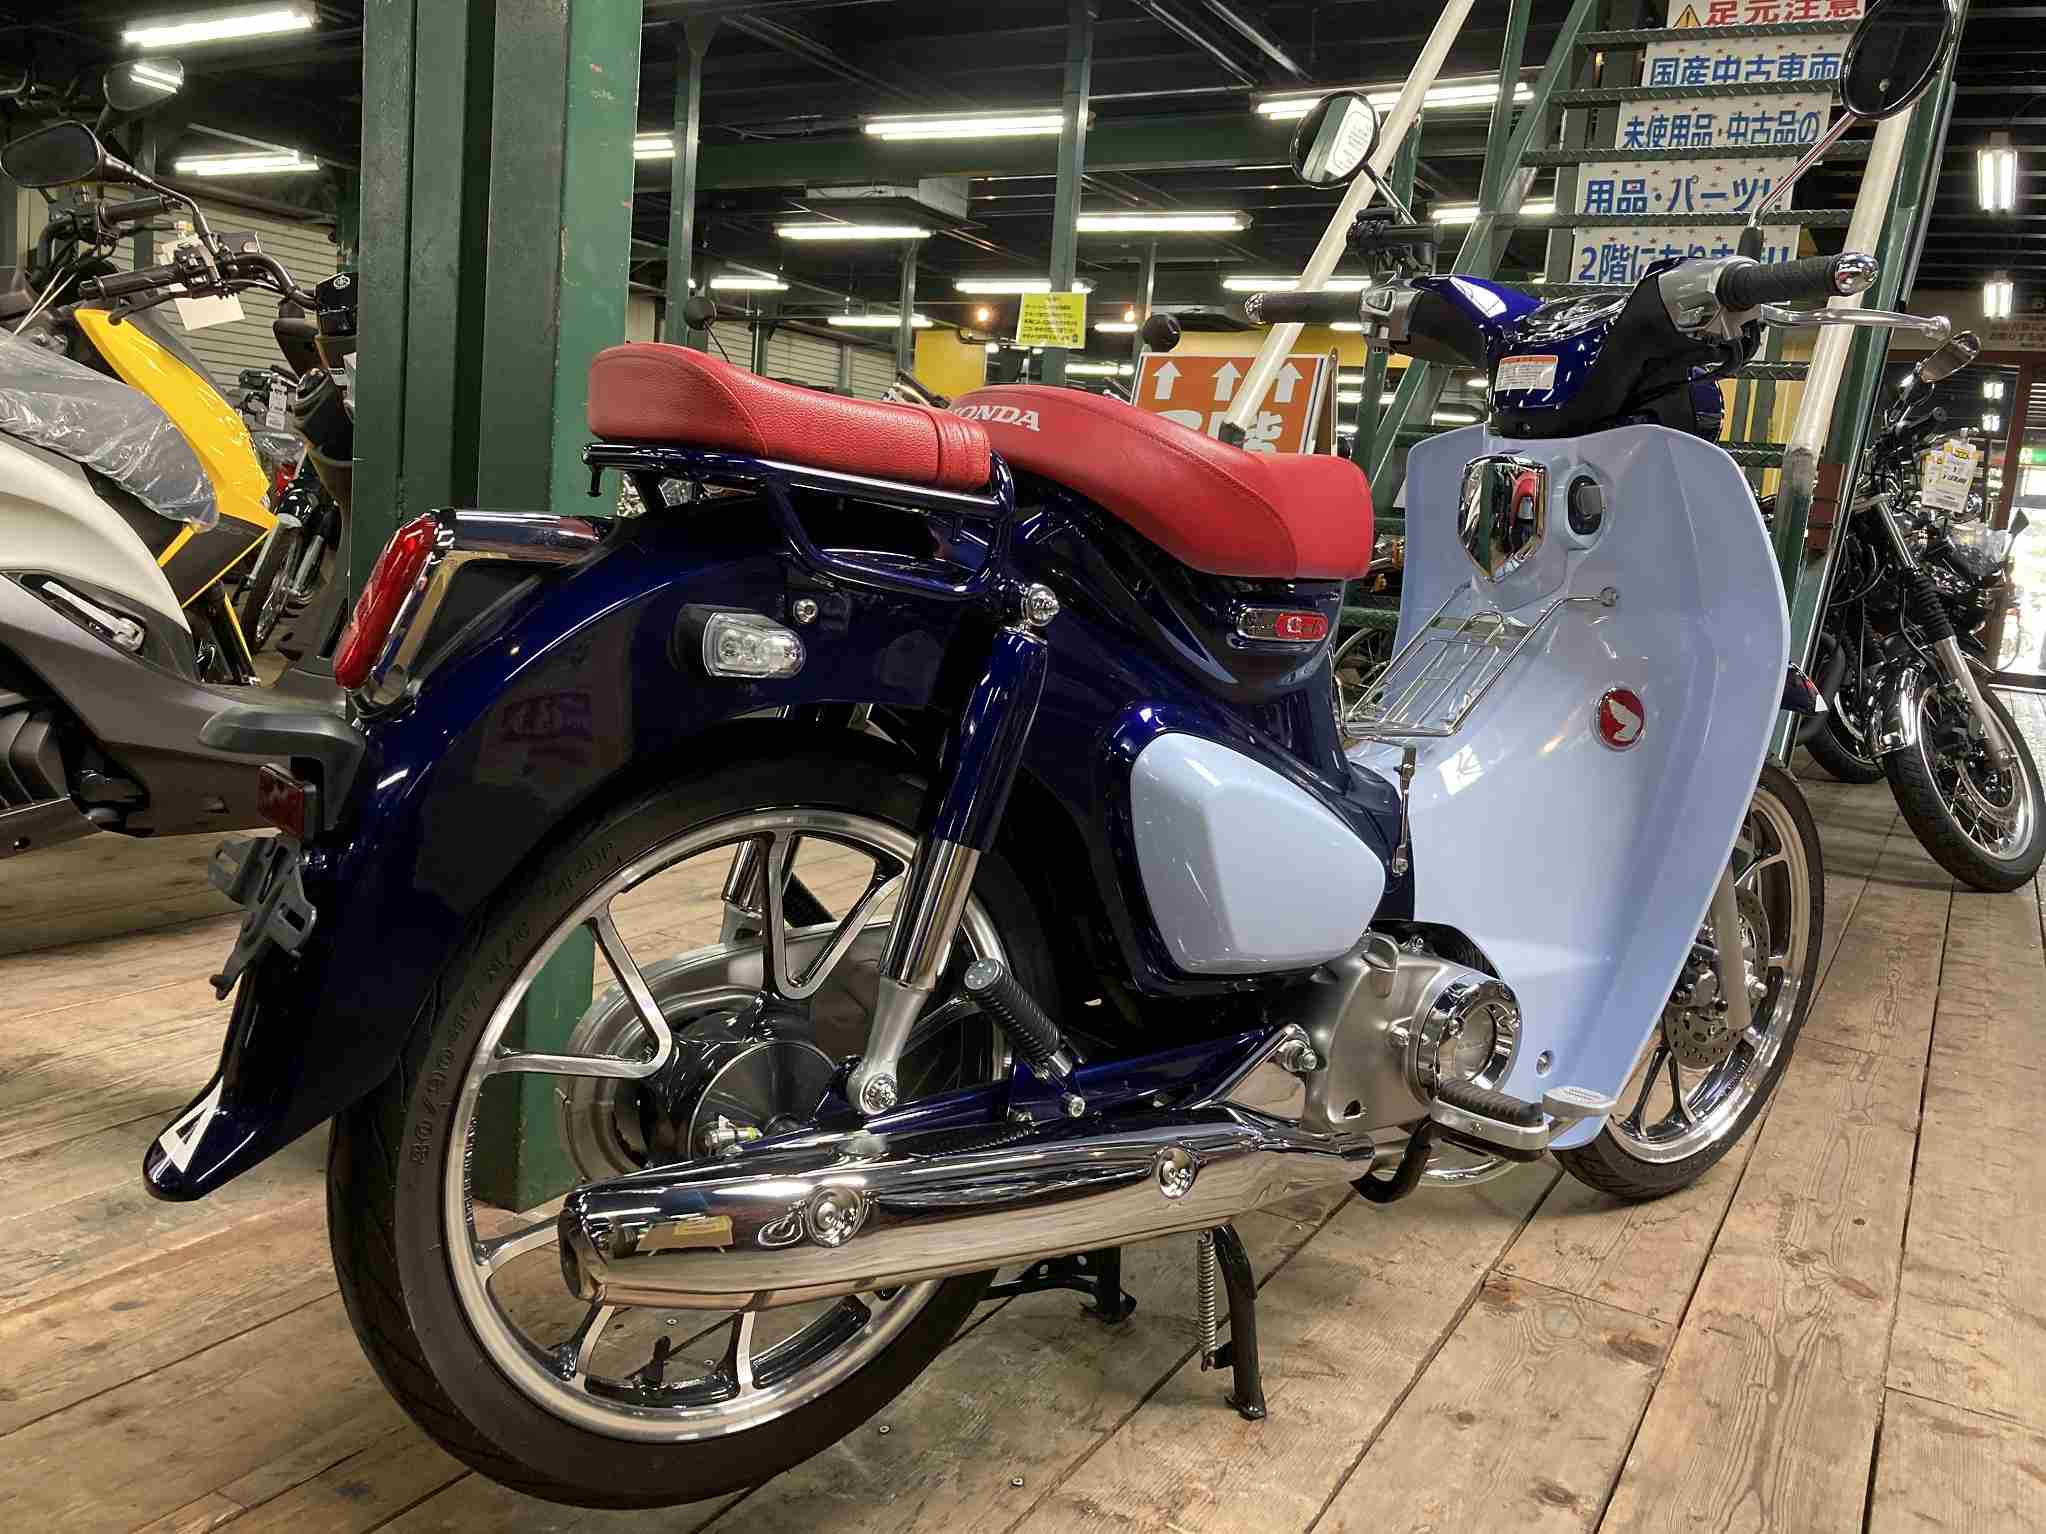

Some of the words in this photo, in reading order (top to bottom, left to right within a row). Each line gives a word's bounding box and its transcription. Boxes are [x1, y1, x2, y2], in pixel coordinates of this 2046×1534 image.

[1622, 111, 1821, 149] 未使用品・中古品の
[952, 404, 1041, 432] ONDA
